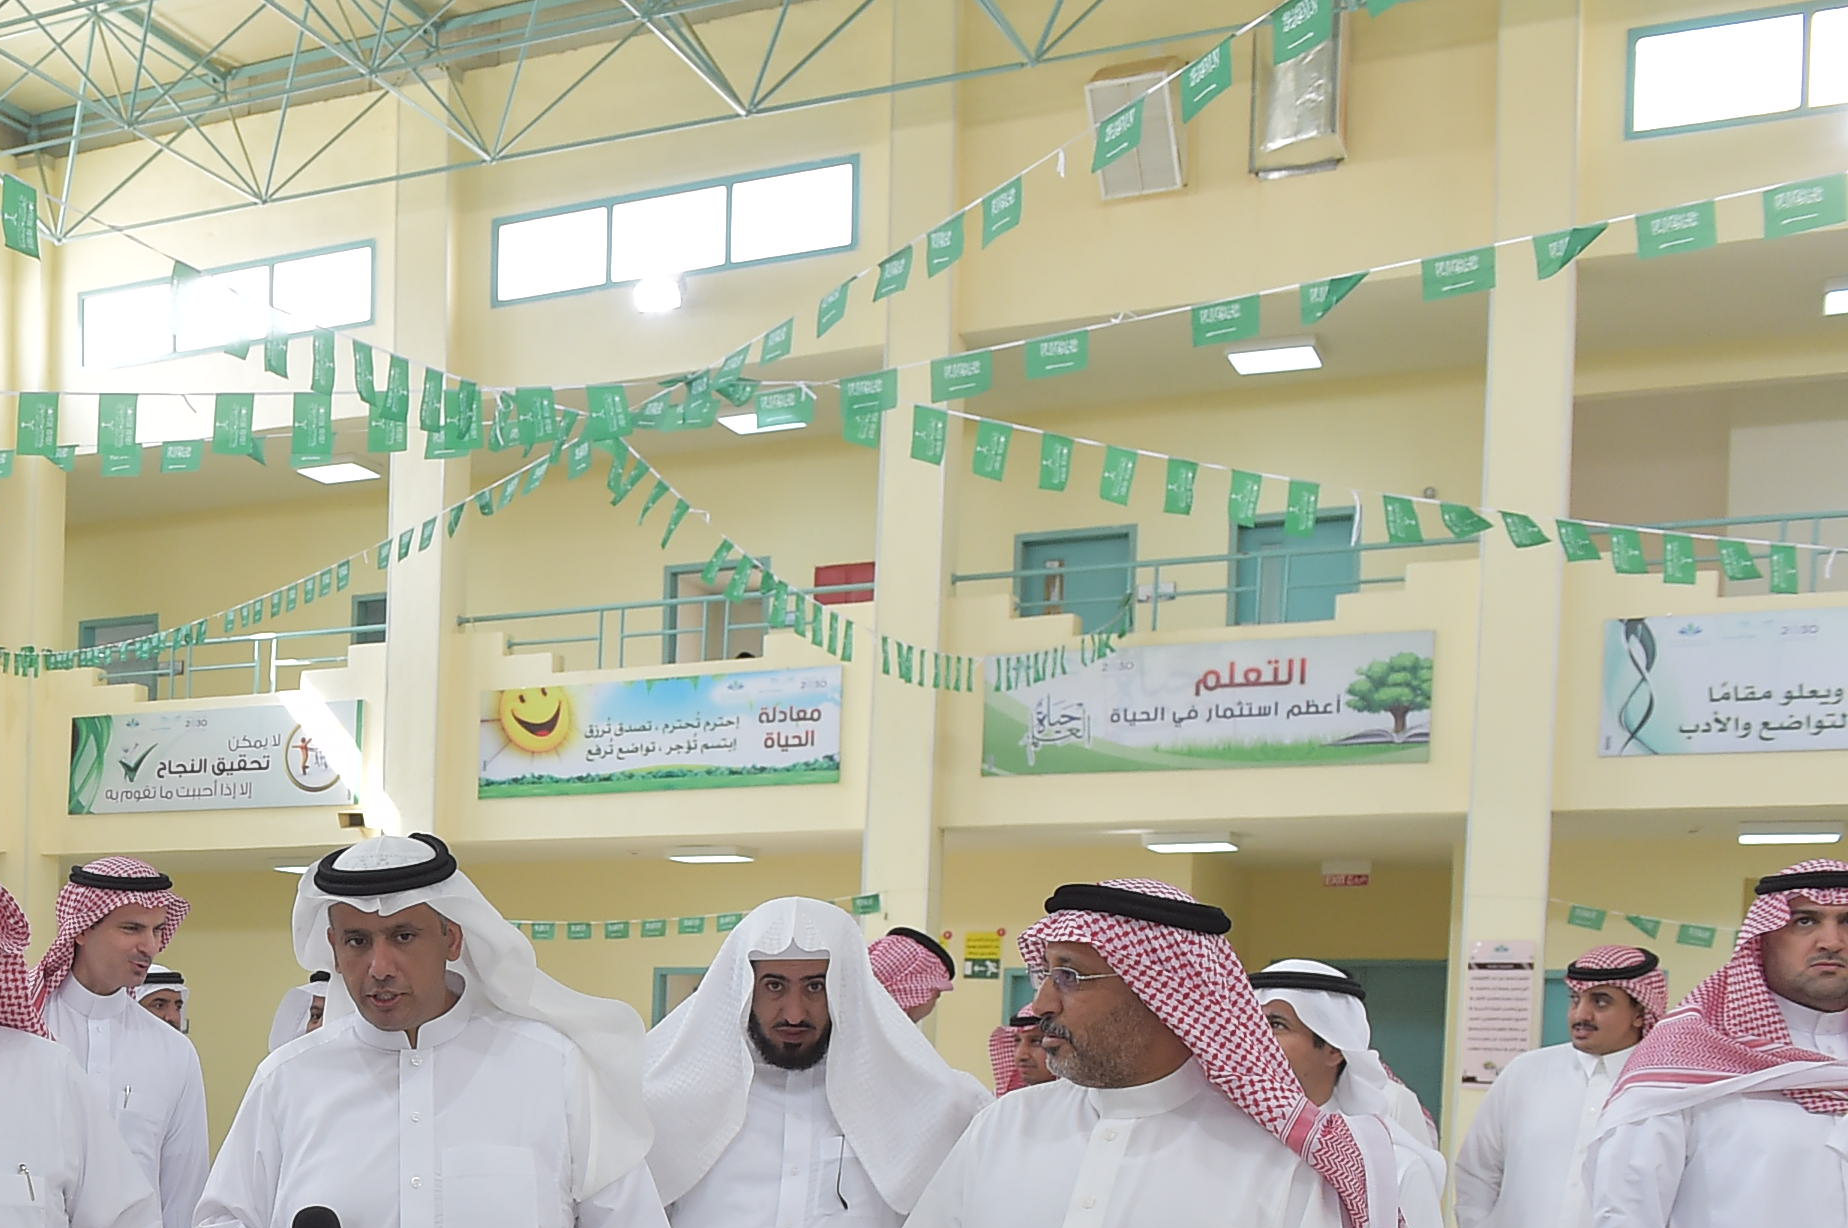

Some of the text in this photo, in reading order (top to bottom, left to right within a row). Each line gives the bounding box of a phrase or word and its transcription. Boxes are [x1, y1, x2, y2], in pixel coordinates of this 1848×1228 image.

[1194, 657, 1307, 697] التعلم
[1778, 683, 1844, 707] ويعلو
[758, 705, 822, 724] معادلة
[1109, 694, 1341, 728] أعظم استثمار في الحياة
[614, 719, 653, 737] تصدق
[1679, 710, 1752, 740] والأدب
[227, 734, 282, 752] لا يمكن
[616, 741, 656, 761] تواضع
[763, 729, 815, 752] الحياة
[156, 754, 271, 779] تحقيق النجاح
[105, 779, 252, 804] إلا إذا أحببت ما تقوم به
